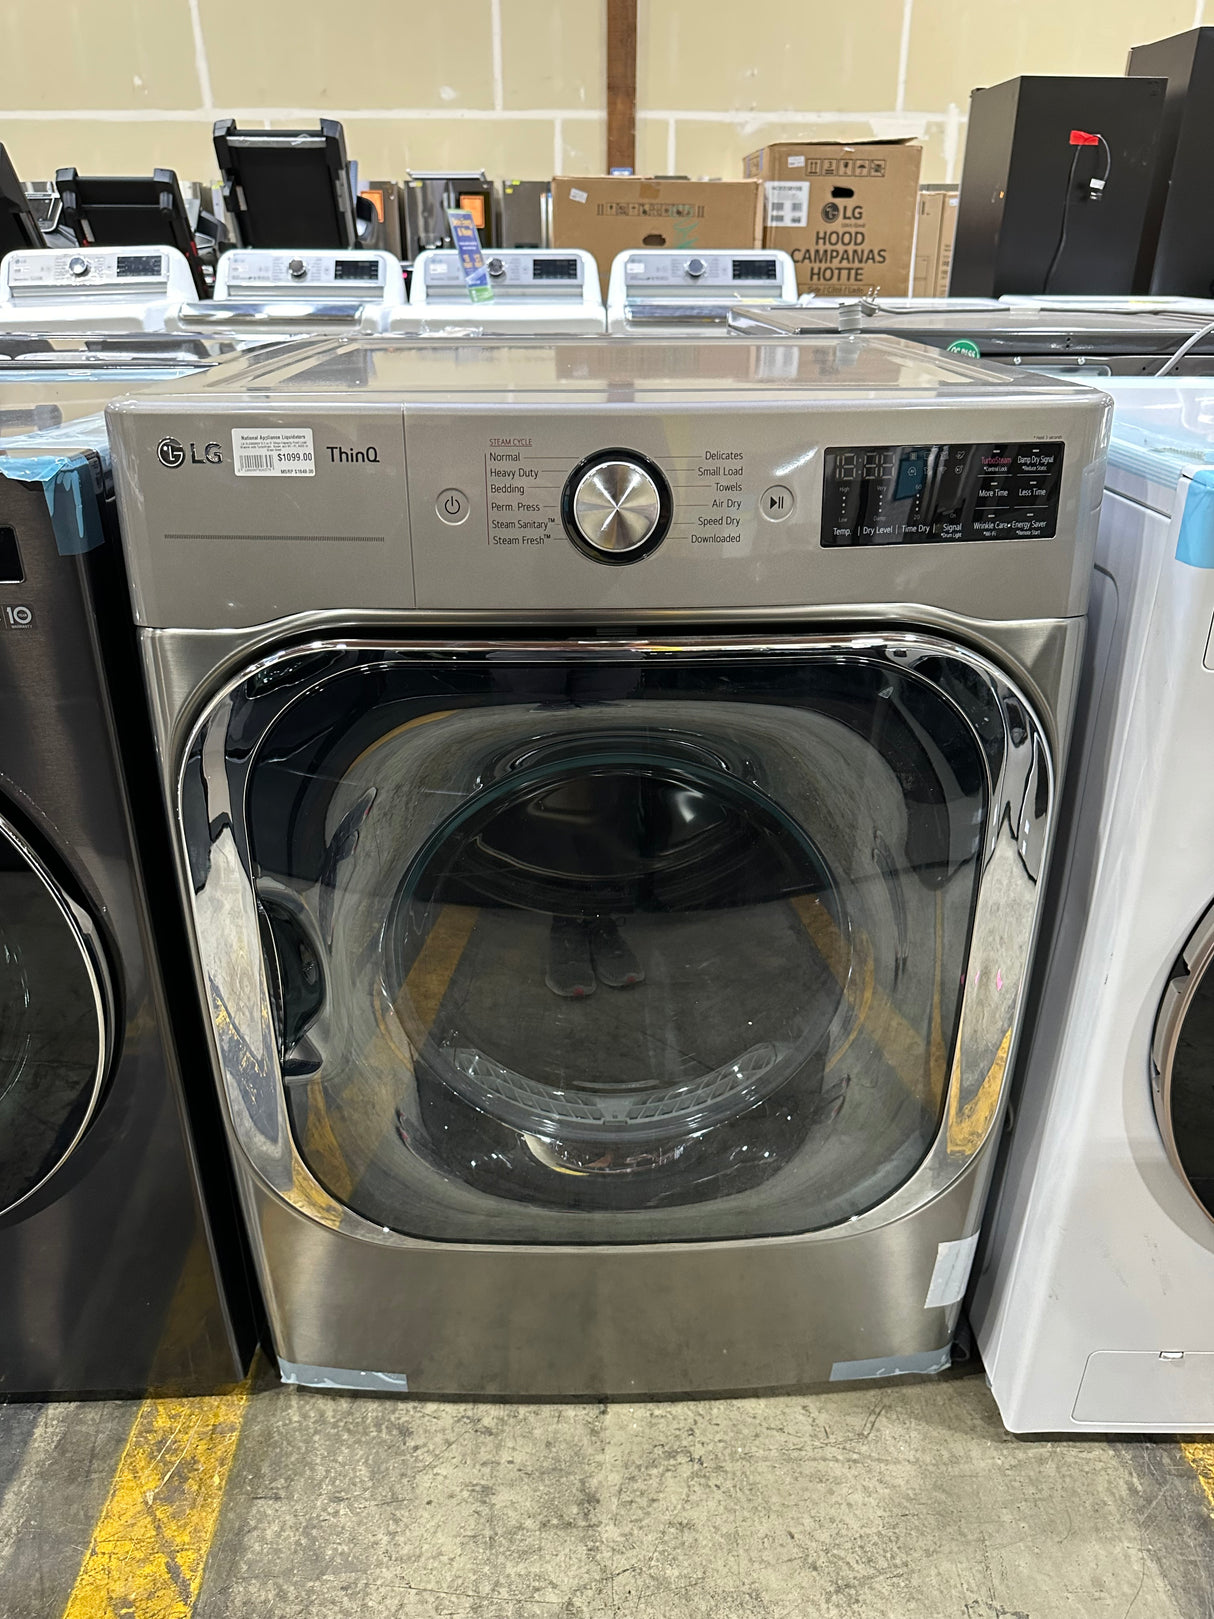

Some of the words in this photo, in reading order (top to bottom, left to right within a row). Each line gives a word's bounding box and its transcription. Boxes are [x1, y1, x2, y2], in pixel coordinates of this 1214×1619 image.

[843, 205, 863, 220] LG
[815, 231, 865, 246] HOOD
[791, 248, 887, 265] CAMPANAS
[810, 267, 864, 282] HOTTE
[489, 438, 511, 446] STEAM
[190, 442, 223, 465] LG
[277, 452, 313, 462] $1099.00
[326, 446, 380, 464] ThinQ
[489, 452, 520, 462] Normal
[705, 450, 743, 460] Delicates
[981, 456, 1012, 465] TurboSteam
[1017, 455, 1031, 465] Damp
[1032, 455, 1040, 464] Dry
[1040, 455, 1054, 465] Signal
[490, 468, 516, 479] Heavy
[518, 468, 539, 479] Duty
[697, 467, 721, 476] Small
[723, 466, 743, 476] Load
[491, 484, 525, 495] Bedding
[715, 482, 742, 492] Towels
[1019, 488, 1031, 496] Less
[1033, 488, 1046, 496] Time
[979, 489, 993, 497] More
[995, 488, 1009, 497] Time
[491, 503, 515, 512] Perm.
[518, 502, 540, 512] Press
[712, 499, 724, 508] Air
[726, 499, 742, 510] Dry
[491, 520, 515, 529] Steam
[698, 516, 723, 527] Speed
[725, 516, 741, 527] Dry
[973, 521, 994, 529] Wrinkle
[995, 521, 1007, 529] Care
[1012, 521, 1030, 529] Energy
[1031, 520, 1047, 528] Saver
[833, 527, 852, 536] Temp.
[863, 527, 875, 536] Dry
[875, 526, 893, 534] Level
[901, 525, 917, 533] Time
[918, 524, 930, 534] Dry
[943, 523, 962, 532] Signal
[493, 536, 520, 545] Steam
[691, 534, 741, 544] Downloaded
[6, 606, 32, 624] 10
